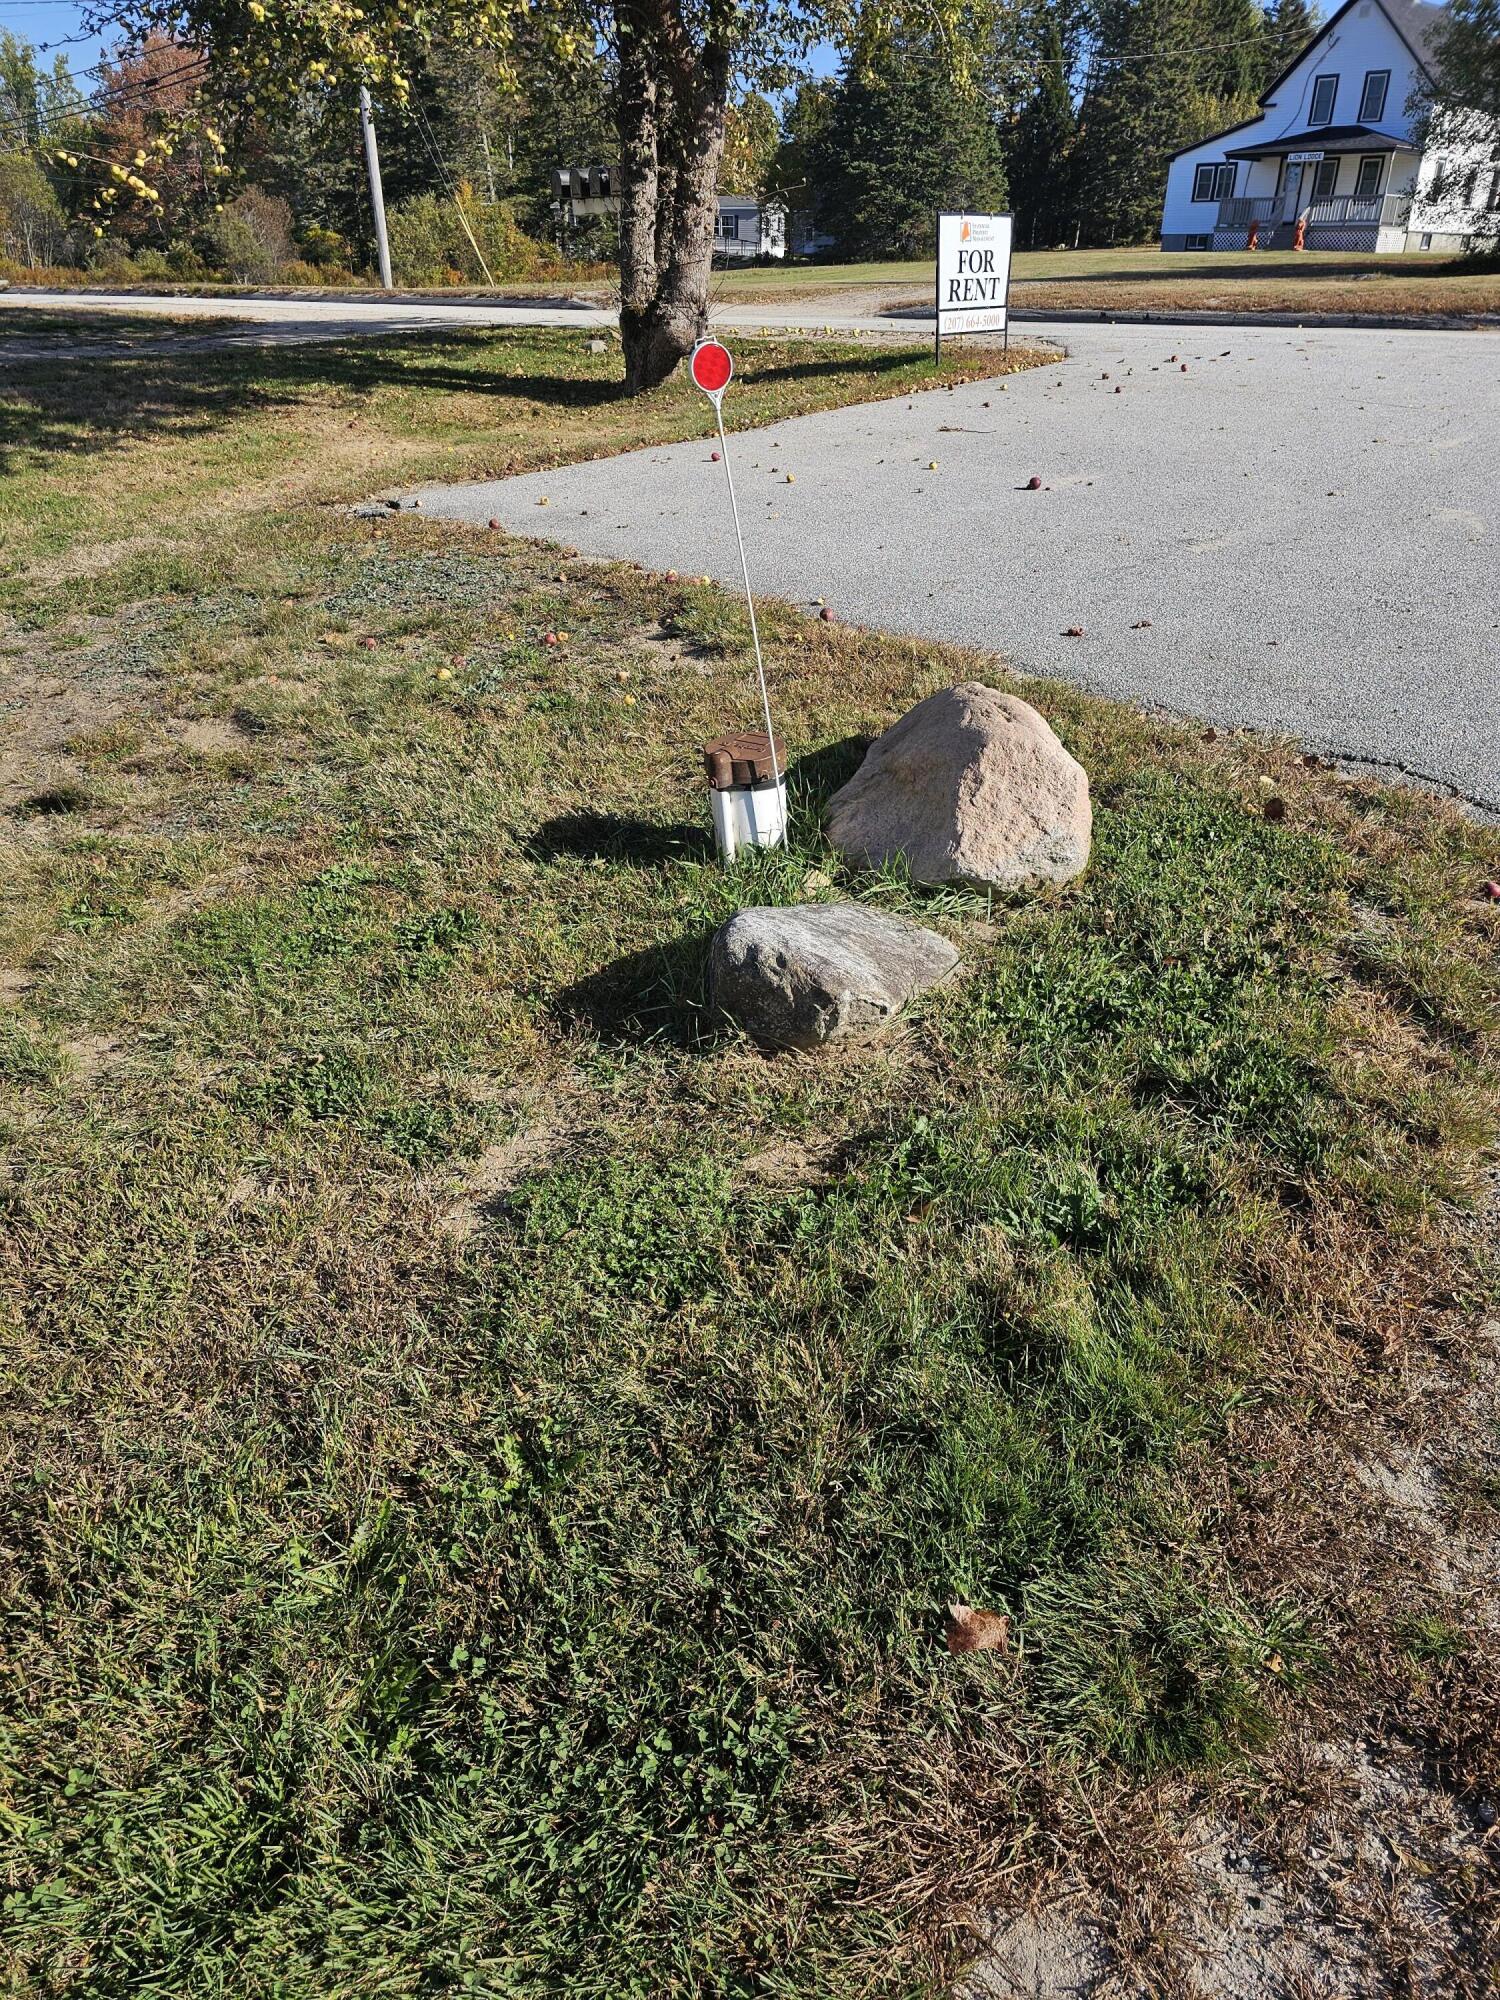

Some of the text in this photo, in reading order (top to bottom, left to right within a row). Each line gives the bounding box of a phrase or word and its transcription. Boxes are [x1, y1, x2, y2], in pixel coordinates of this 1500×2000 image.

[957, 250, 994, 273] FOR
[948, 277, 1000, 302] RENT
[944, 313, 1000, 332] (207) 664-5000
